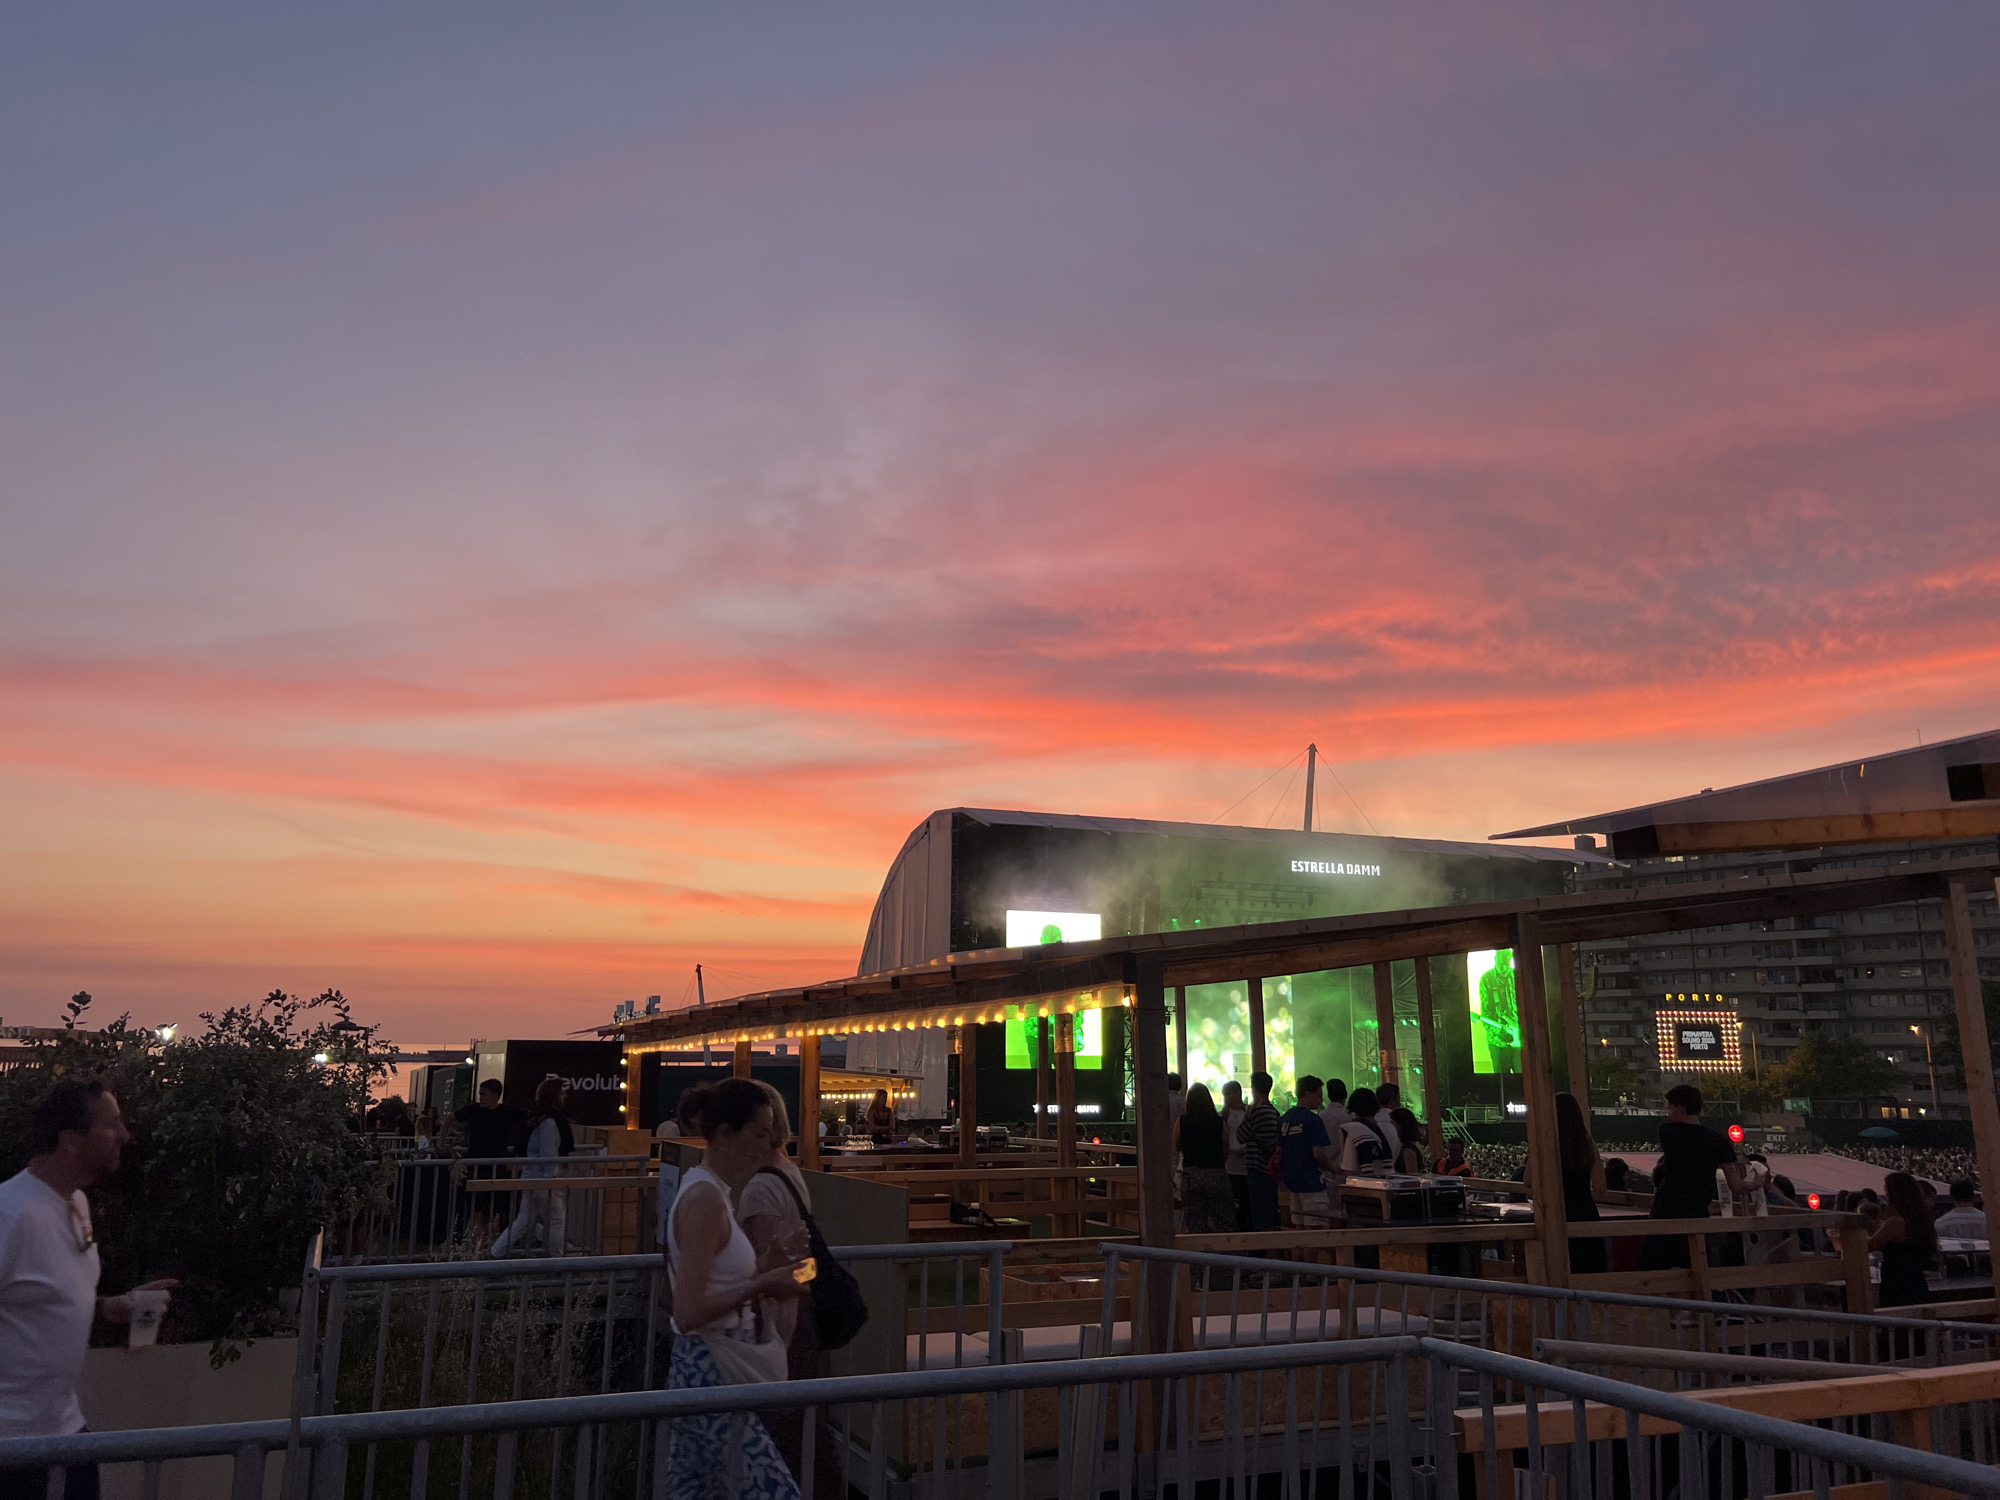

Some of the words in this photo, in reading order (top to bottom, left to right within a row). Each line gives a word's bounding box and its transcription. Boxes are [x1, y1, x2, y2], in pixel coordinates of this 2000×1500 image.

[1291, 860, 1344, 874] ESTRELLA
[1346, 863, 1381, 876] DAMM
[1665, 993, 1724, 1002] PORTO
[1766, 1134, 1787, 1142] EXIT
